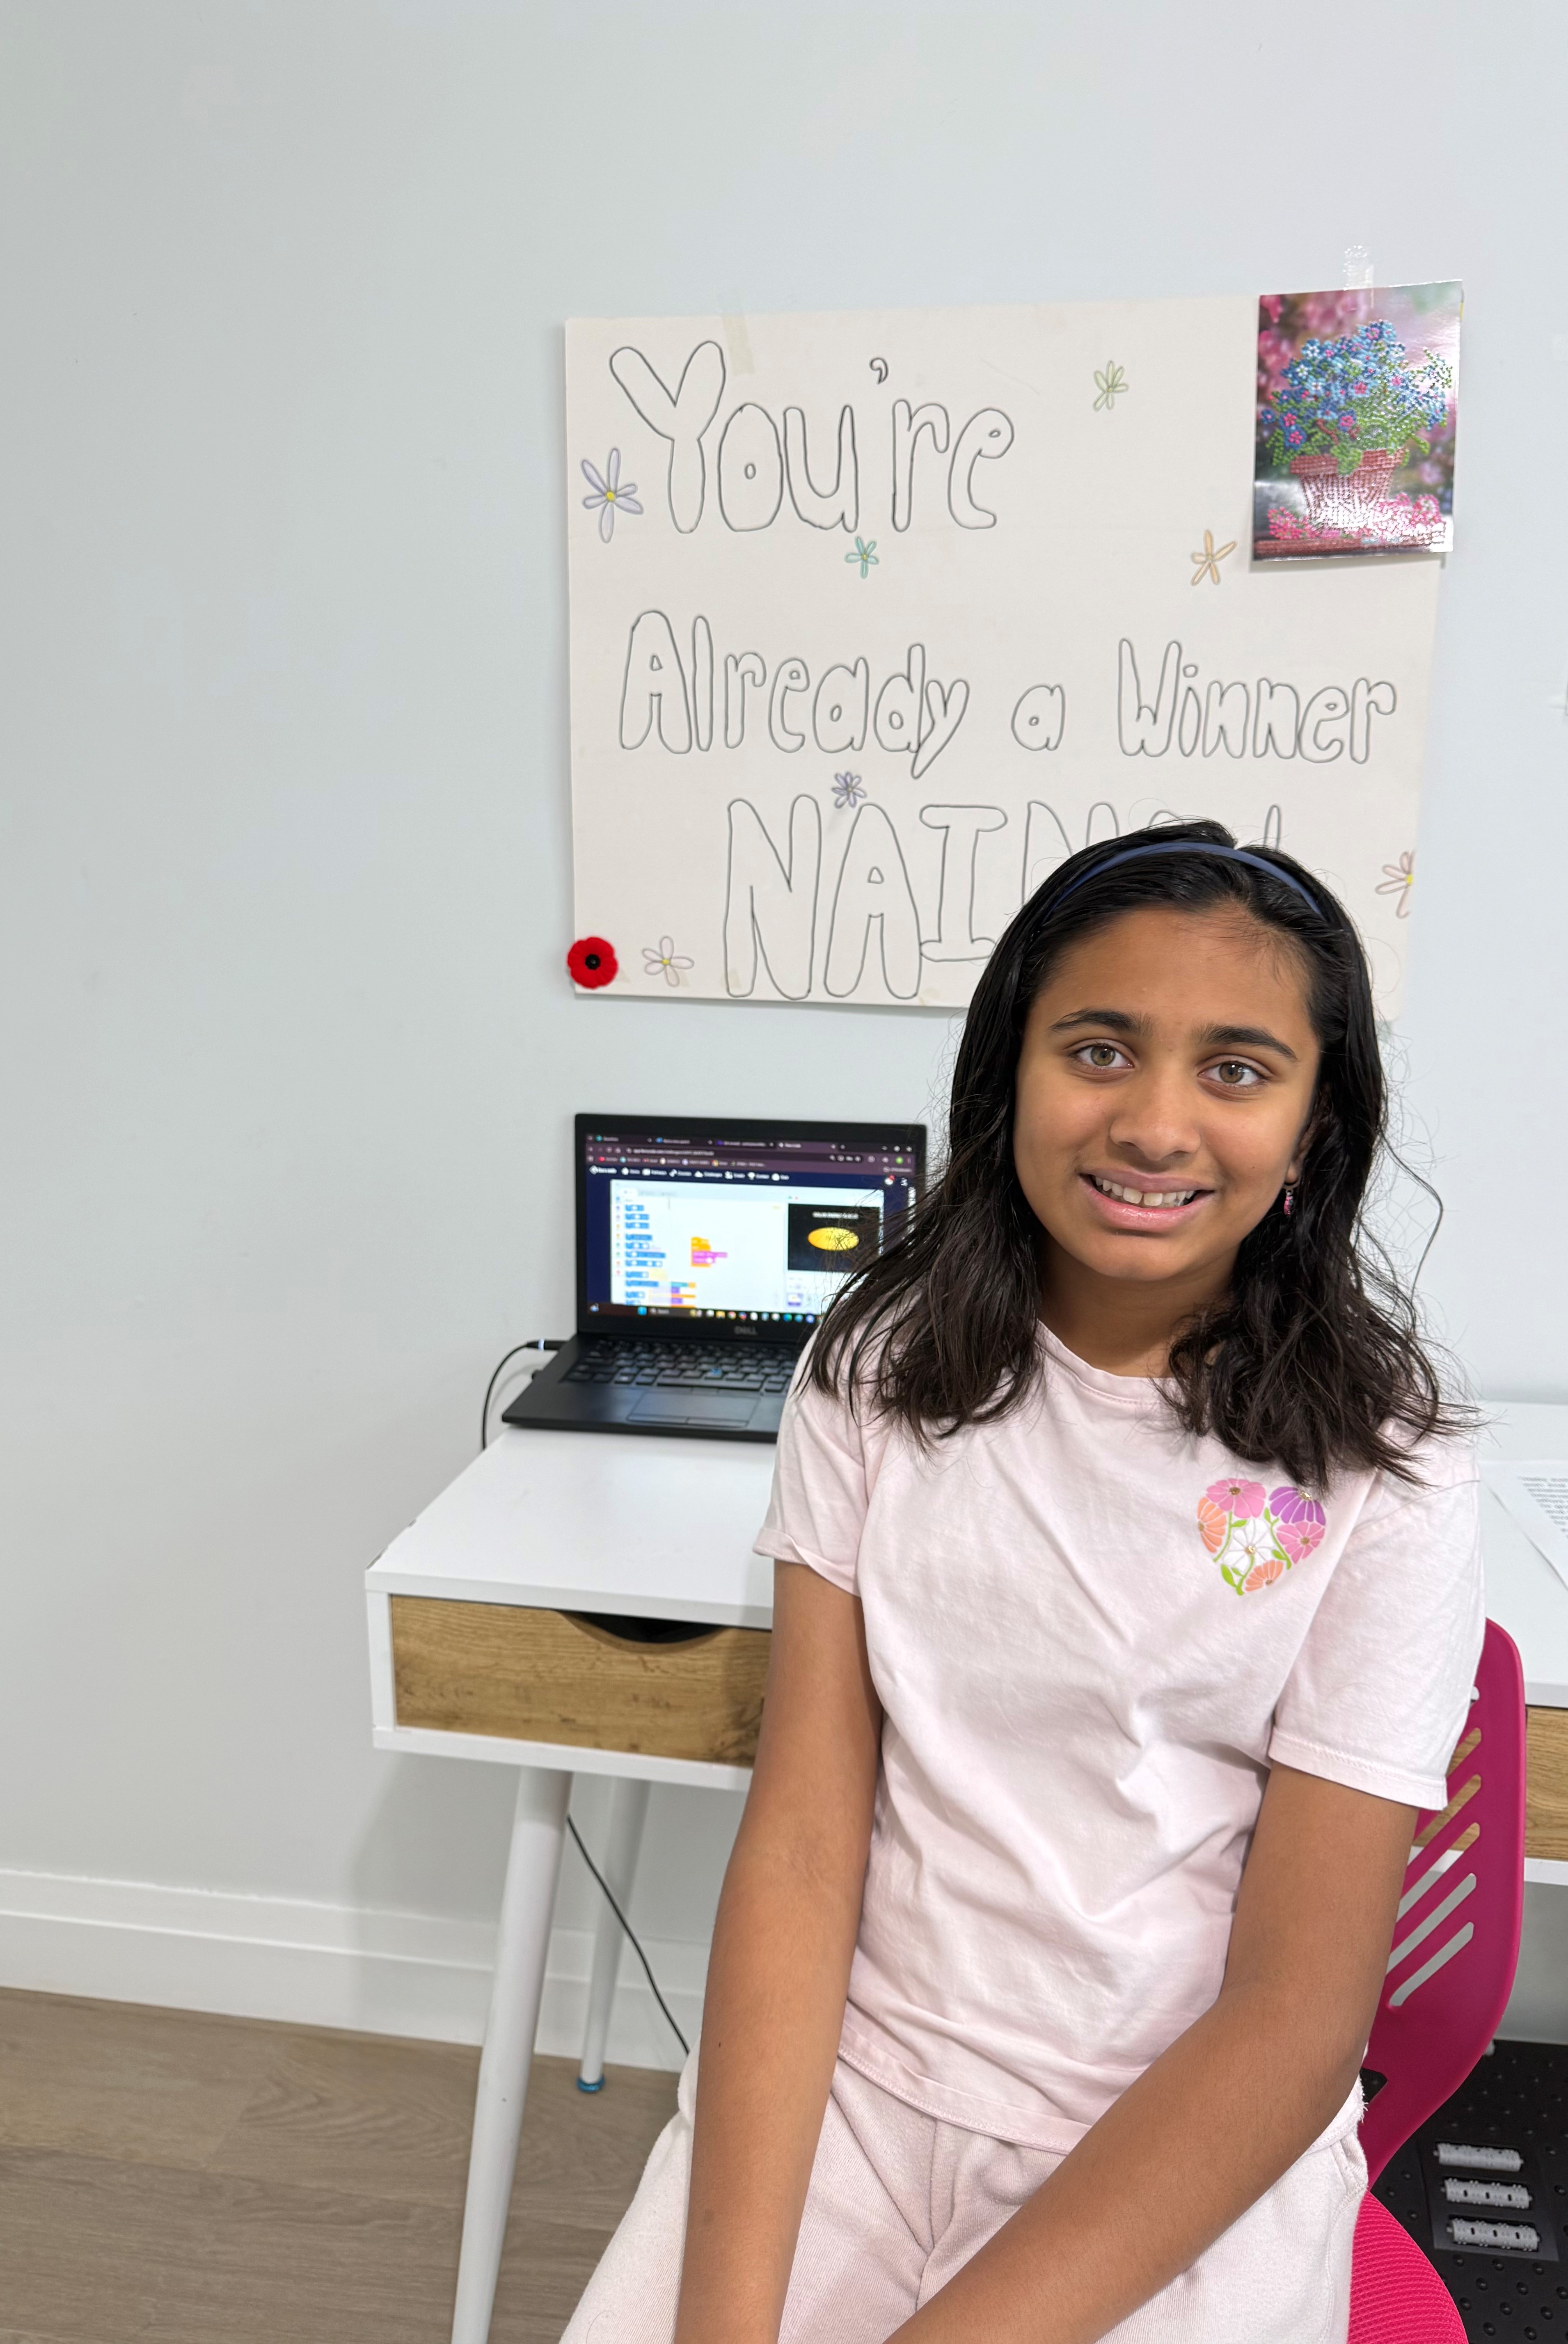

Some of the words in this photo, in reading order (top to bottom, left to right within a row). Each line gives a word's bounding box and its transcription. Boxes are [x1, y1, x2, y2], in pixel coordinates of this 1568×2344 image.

[609, 341, 1014, 533] You're
[618, 610, 969, 779] Already
[1011, 683, 1066, 751] a
[1117, 638, 1396, 764] Winner
[723, 794, 1282, 1000] NAI
